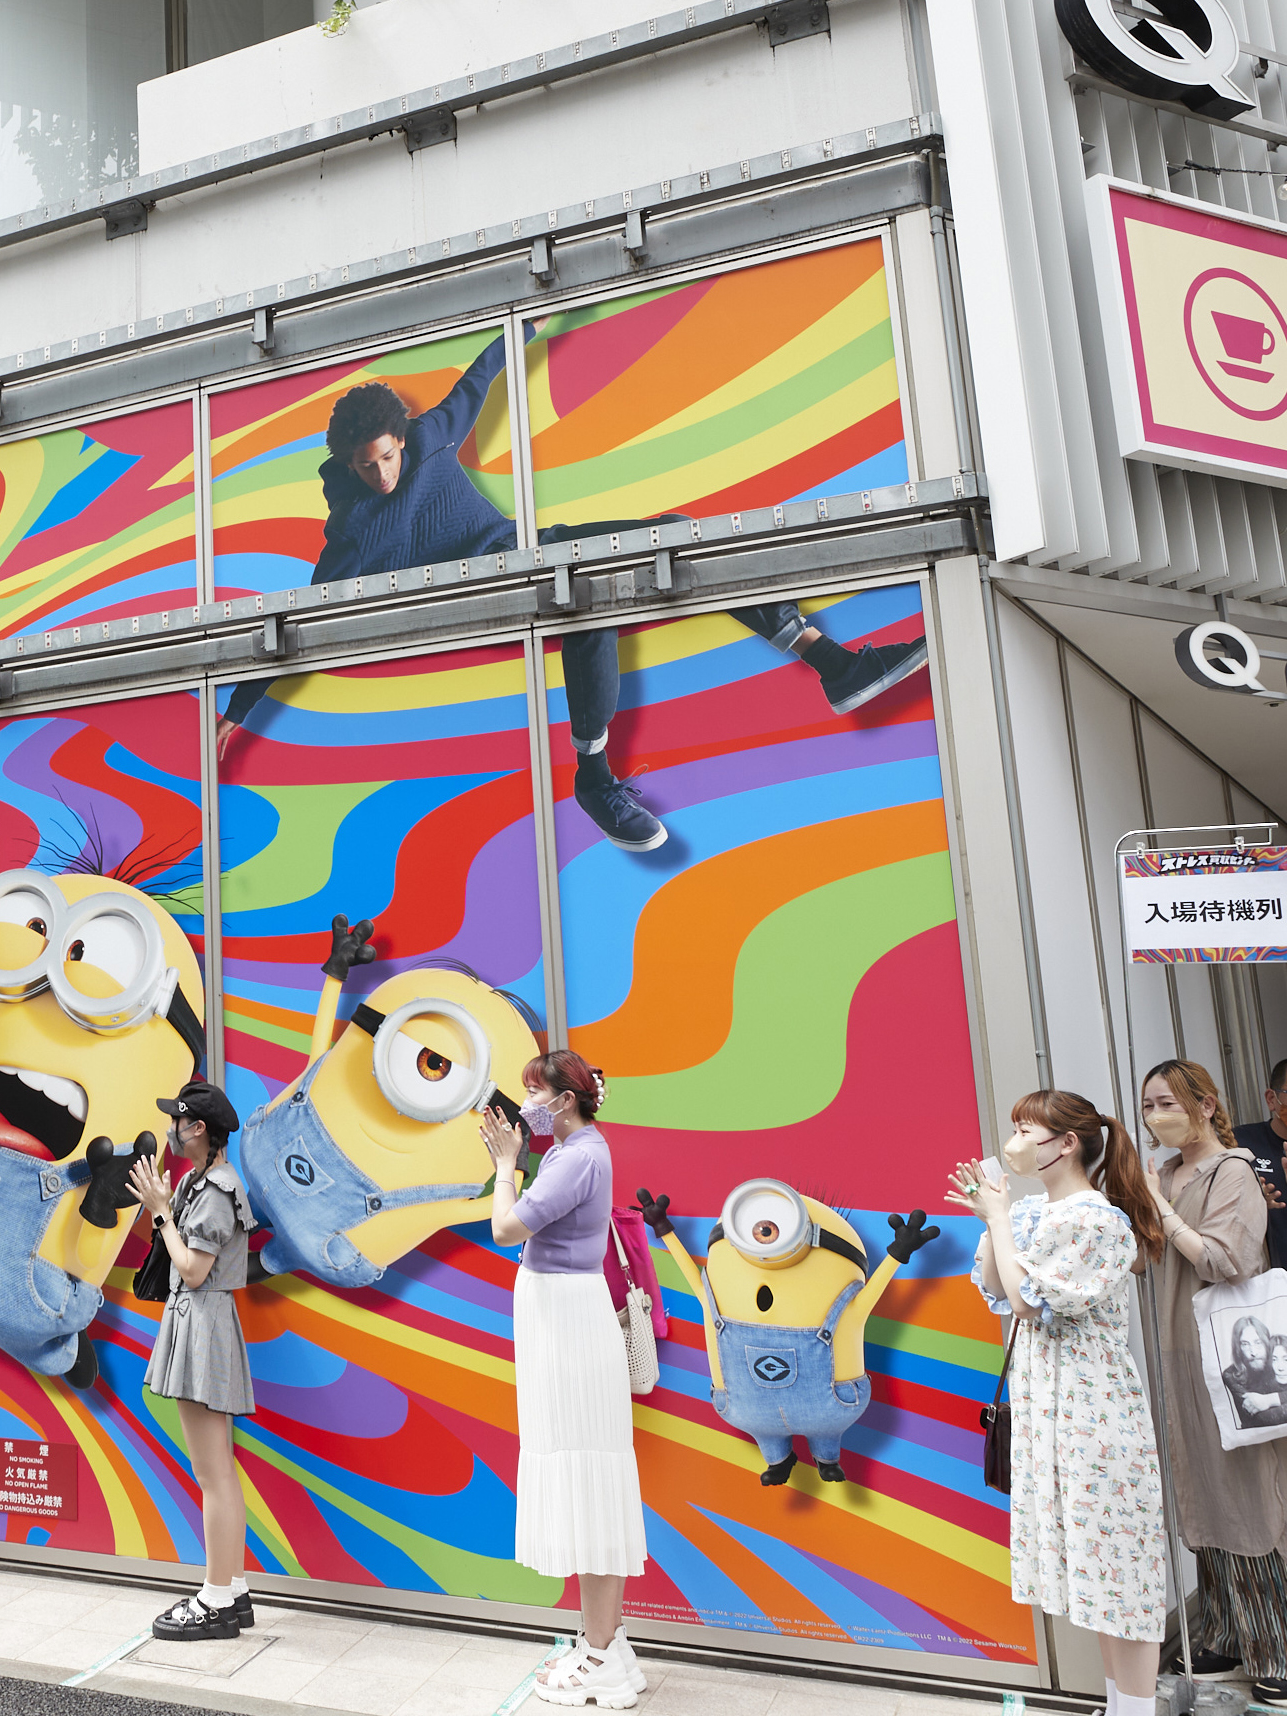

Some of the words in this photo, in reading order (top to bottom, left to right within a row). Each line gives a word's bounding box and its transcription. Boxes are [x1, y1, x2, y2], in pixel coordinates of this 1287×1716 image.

[1144, 898, 1283, 924] 入場待機列
[9, 1455, 18, 1463] NO
[18, 1456, 44, 1465] SMOKING
[4, 1466, 49, 1482] 火気厳禁
[14, 1481, 30, 1489] OPEN
[29, 1482, 49, 1491] FLAME
[4, 1504, 38, 1515] DANGEROUS
[38, 1508, 59, 1517] GOODS
[630, 1609, 653, 1617] Universal
[937, 1634, 947, 1642] TM
[959, 1637, 973, 1645] 2022
[974, 1638, 997, 1648] Sesame
[998, 1641, 1027, 1652] Workshop
